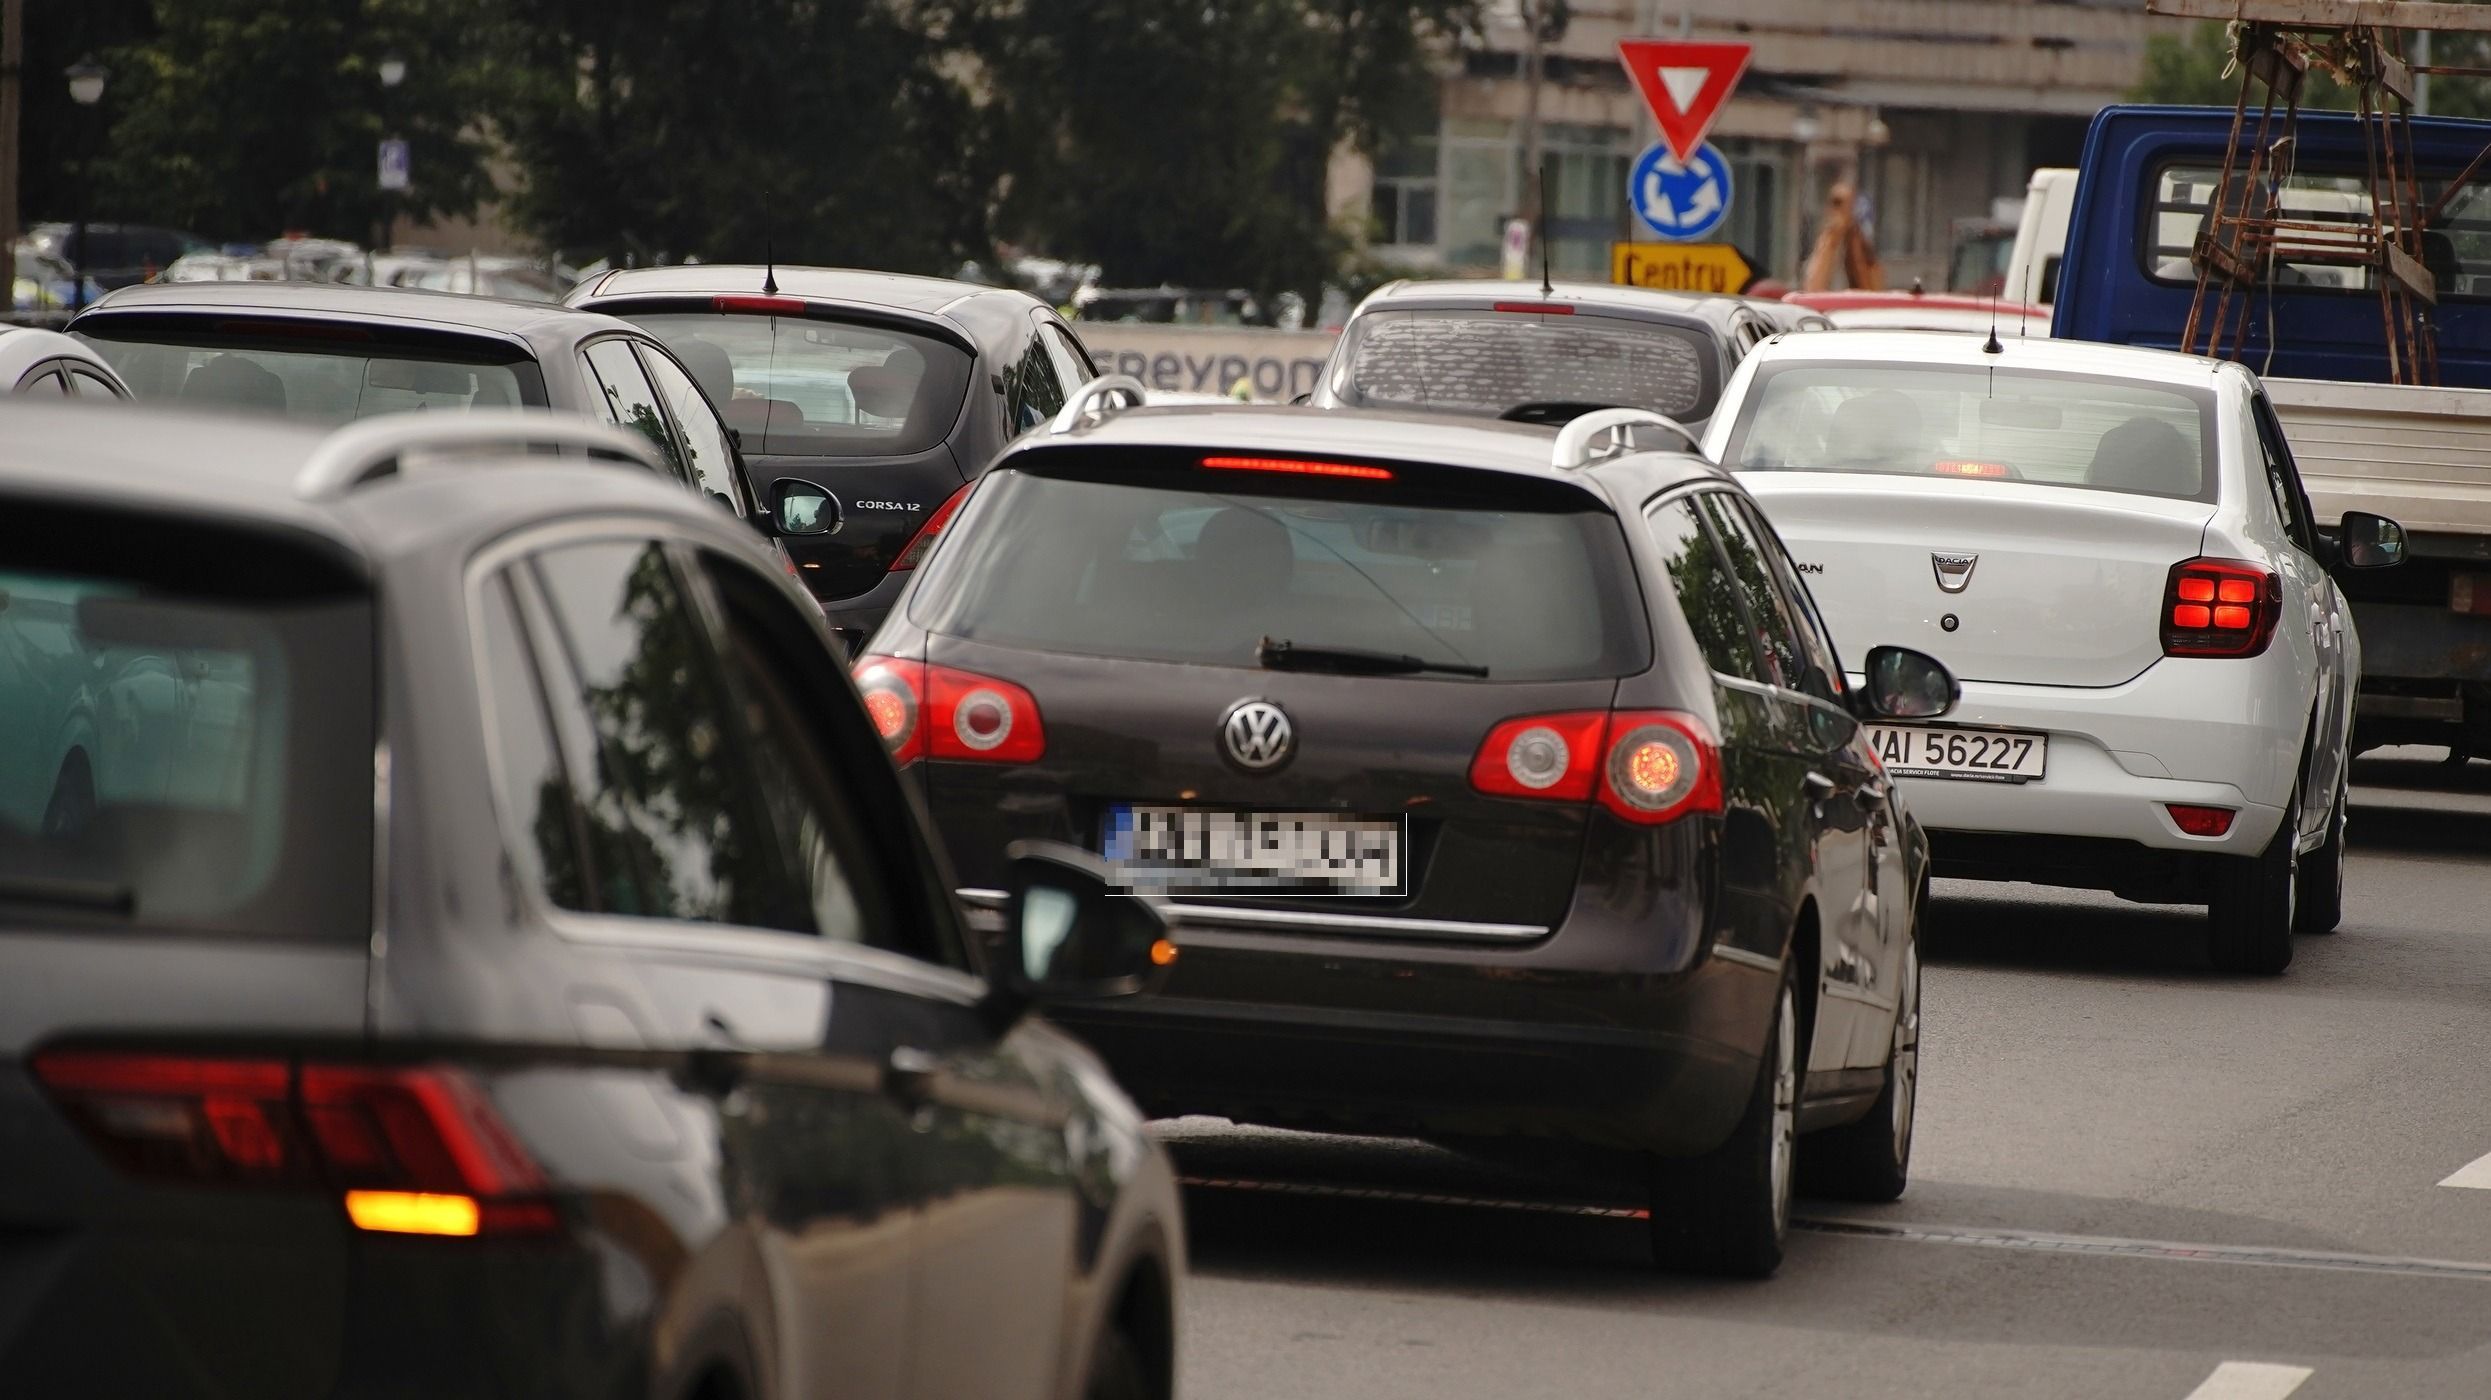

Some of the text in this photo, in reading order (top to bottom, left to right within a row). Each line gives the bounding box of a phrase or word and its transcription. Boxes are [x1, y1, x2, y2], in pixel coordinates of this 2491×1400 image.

[1625, 253, 1726, 293] Centru
[856, 500, 904, 511] CORSA
[1938, 557, 1969, 565] DACIA
[1225, 702, 1291, 768] VW
[1925, 733, 2033, 771] 56227
